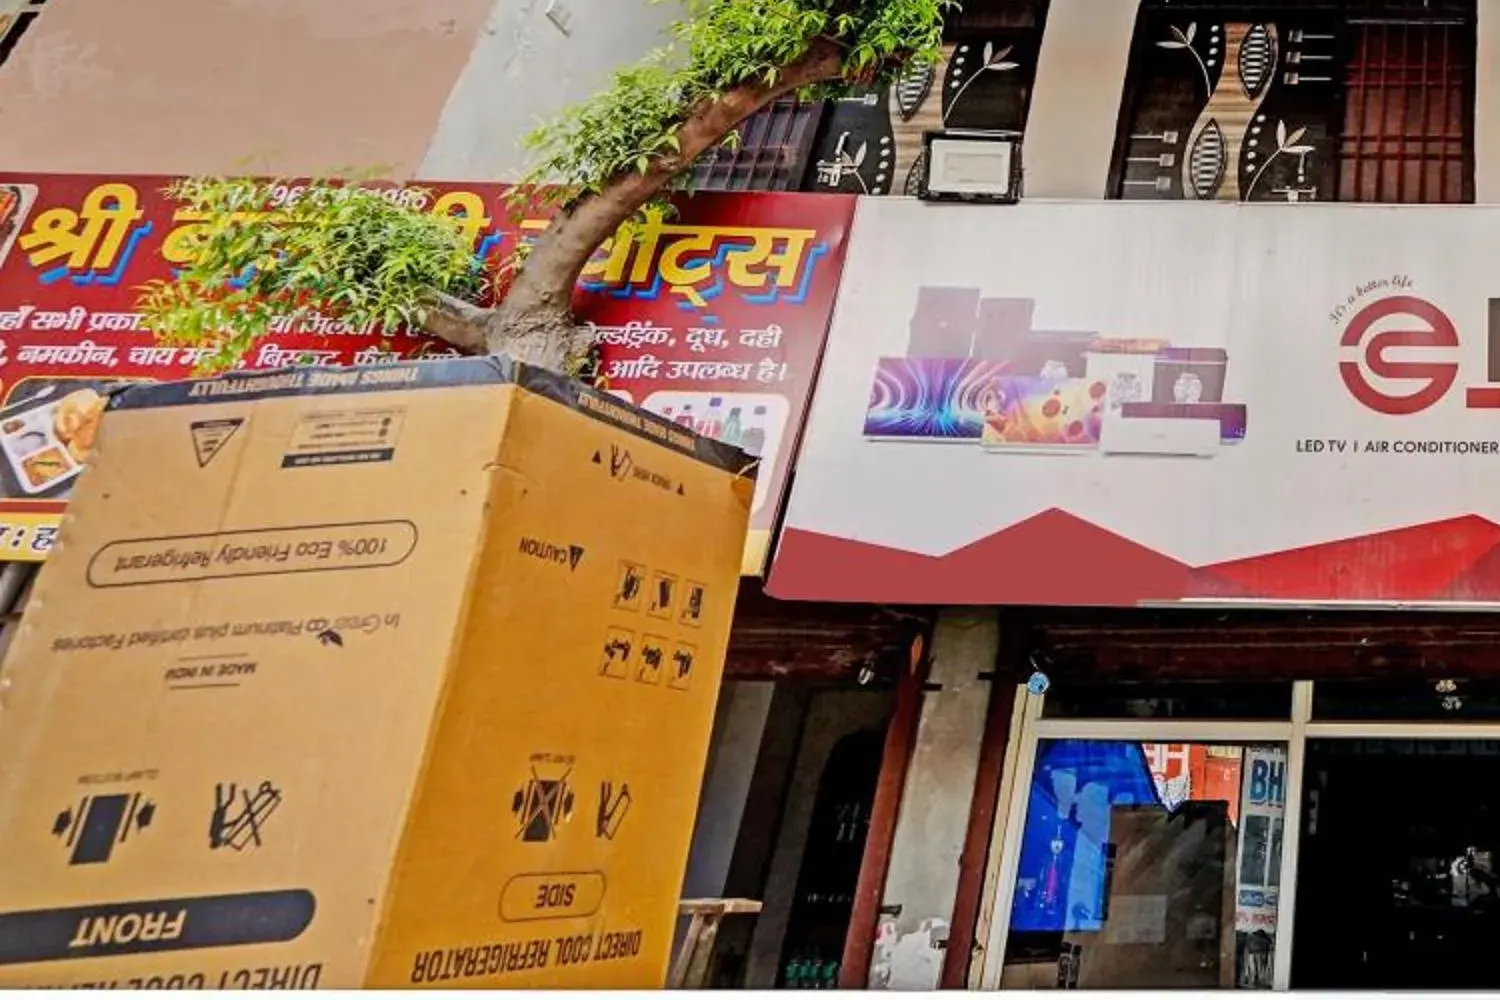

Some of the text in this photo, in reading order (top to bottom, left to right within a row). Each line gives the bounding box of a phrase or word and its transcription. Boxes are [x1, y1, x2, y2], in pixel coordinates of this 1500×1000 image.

[17, 183, 148, 280] श्री
[31, 305, 87, 331] सभी
[85, 311, 153, 333] प्रका
[739, 323, 784, 348] दही
[17, 339, 120, 368] नमकीन,
[128, 346, 176, 367] चाय
[605, 354, 663, 380] आदि
[666, 360, 753, 380] उपलब्ध
[1296, 439, 1325, 454] LED
[1327, 439, 1348, 454] TV
[1364, 440, 1390, 455] AIR
[1392, 440, 1500, 455] CONDITIONER
[114, 537, 388, 573] 100% Eco Friendly Refrigerant
[519, 536, 567, 565] CAUTION
[193, 623, 230, 641] plus
[232, 620, 304, 641] Platinum
[535, 884, 576, 909] SIDE
[69, 908, 188, 948] FRONT
[411, 930, 642, 984] DIRECT COOL REFRIGERATOR
